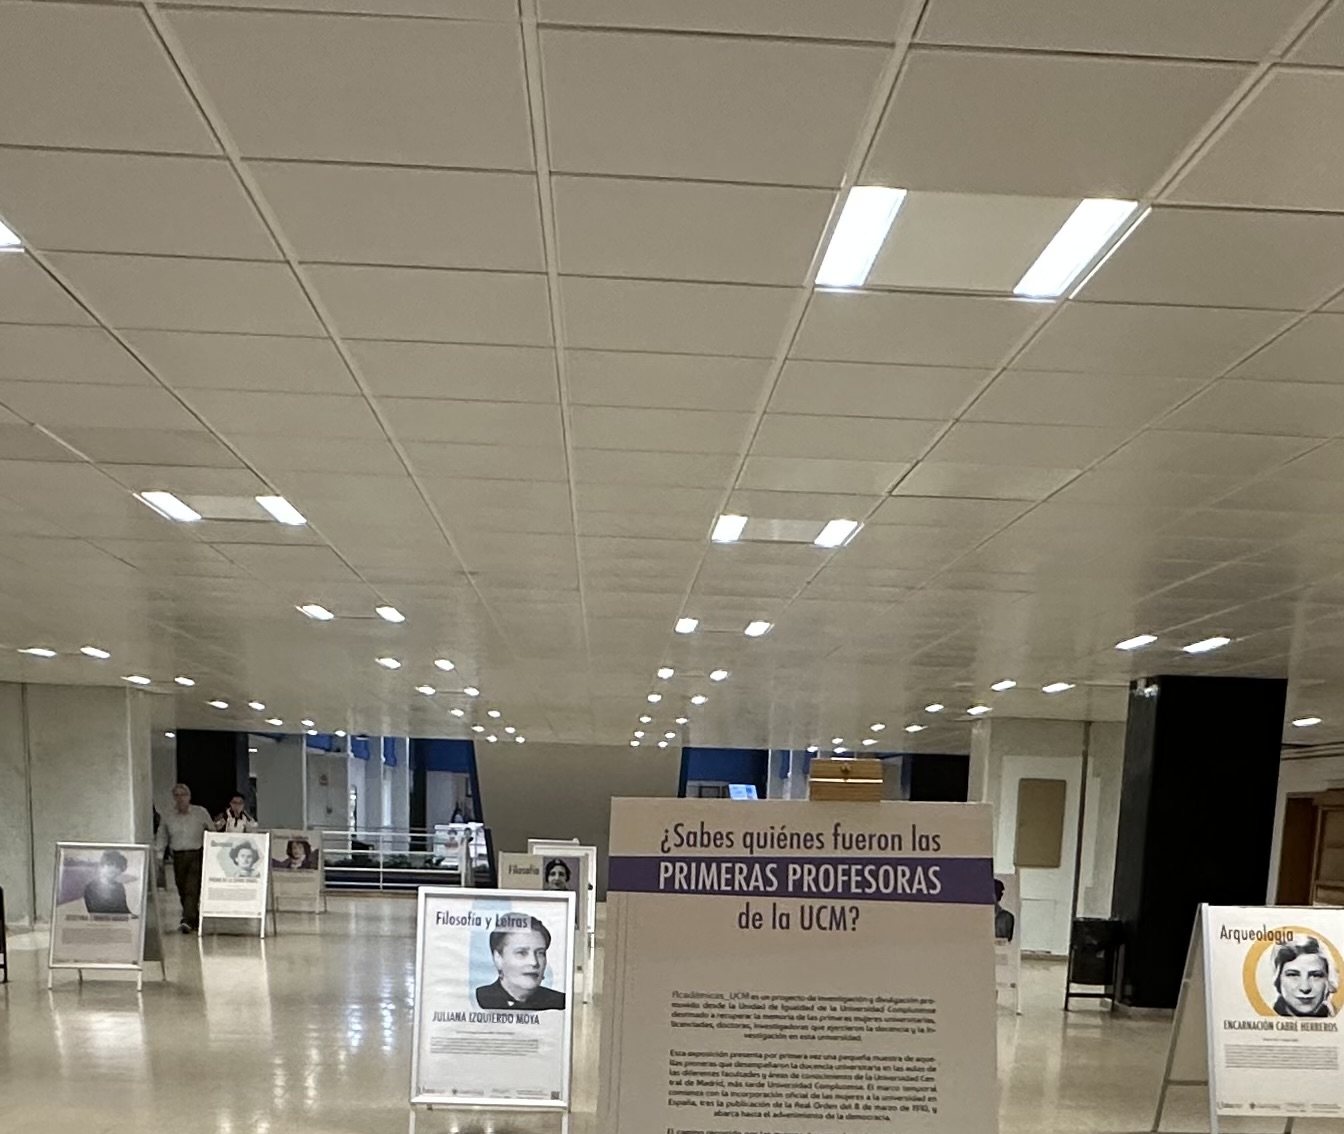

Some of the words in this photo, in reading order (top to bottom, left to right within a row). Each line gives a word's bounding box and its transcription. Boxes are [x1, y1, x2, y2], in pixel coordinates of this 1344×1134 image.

[661, 821, 735, 854] ¿Sabes
[742, 825, 826, 855] quiénes
[832, 823, 903, 852] fueron
[911, 824, 942, 853] las
[659, 862, 777, 890] PRIMERAS
[788, 864, 940, 893] PROFESORAS
[485, 917, 492, 930] y
[496, 914, 528, 928] Letras
[738, 901, 762, 929] de
[772, 902, 789, 929] la
[800, 904, 859, 931] UCM?
[432, 1011, 466, 1023] JULIANA
[469, 1012, 514, 1024] IZQUIERDO
[516, 1014, 540, 1025] MOYA
